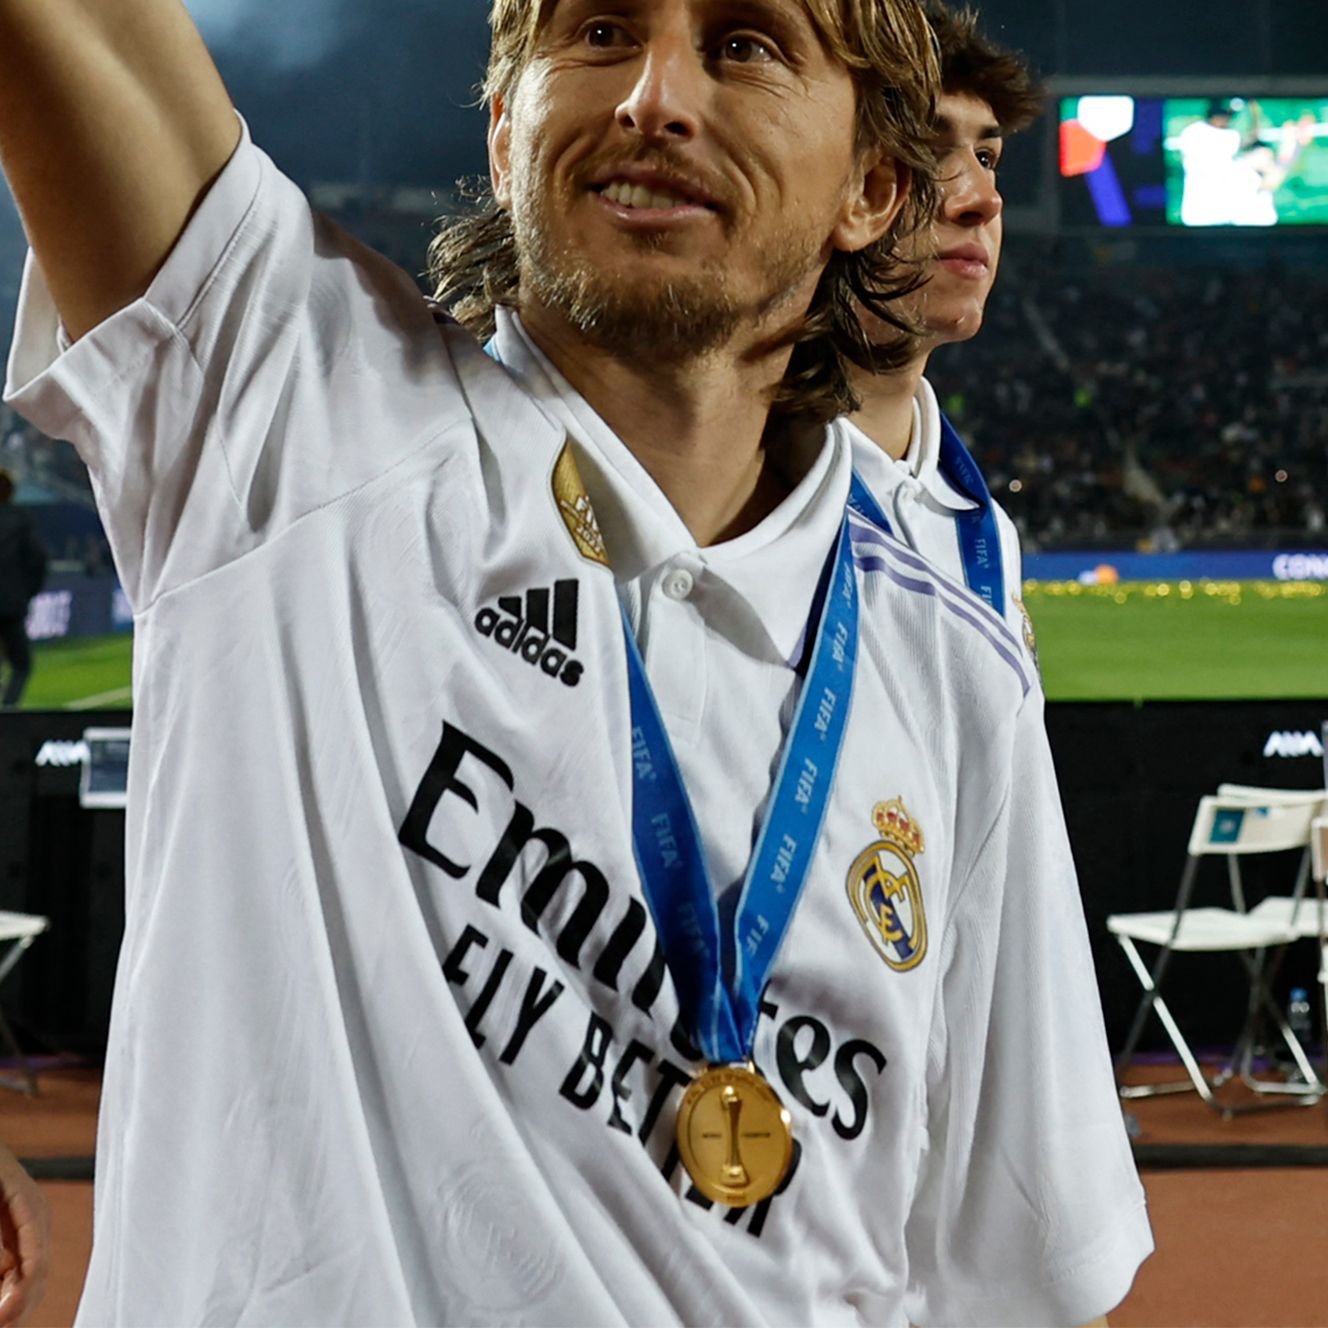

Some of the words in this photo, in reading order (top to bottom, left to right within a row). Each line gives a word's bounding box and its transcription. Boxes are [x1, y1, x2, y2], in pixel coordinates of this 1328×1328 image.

[975, 538, 988, 570] FIFA
[474, 607, 585, 688] adidas
[832, 622, 849, 661] FIFA
[814, 687, 837, 732] FIFA
[795, 757, 819, 808] FIFA
[652, 813, 679, 868] FIFA
[771, 833, 797, 884] FIFA
